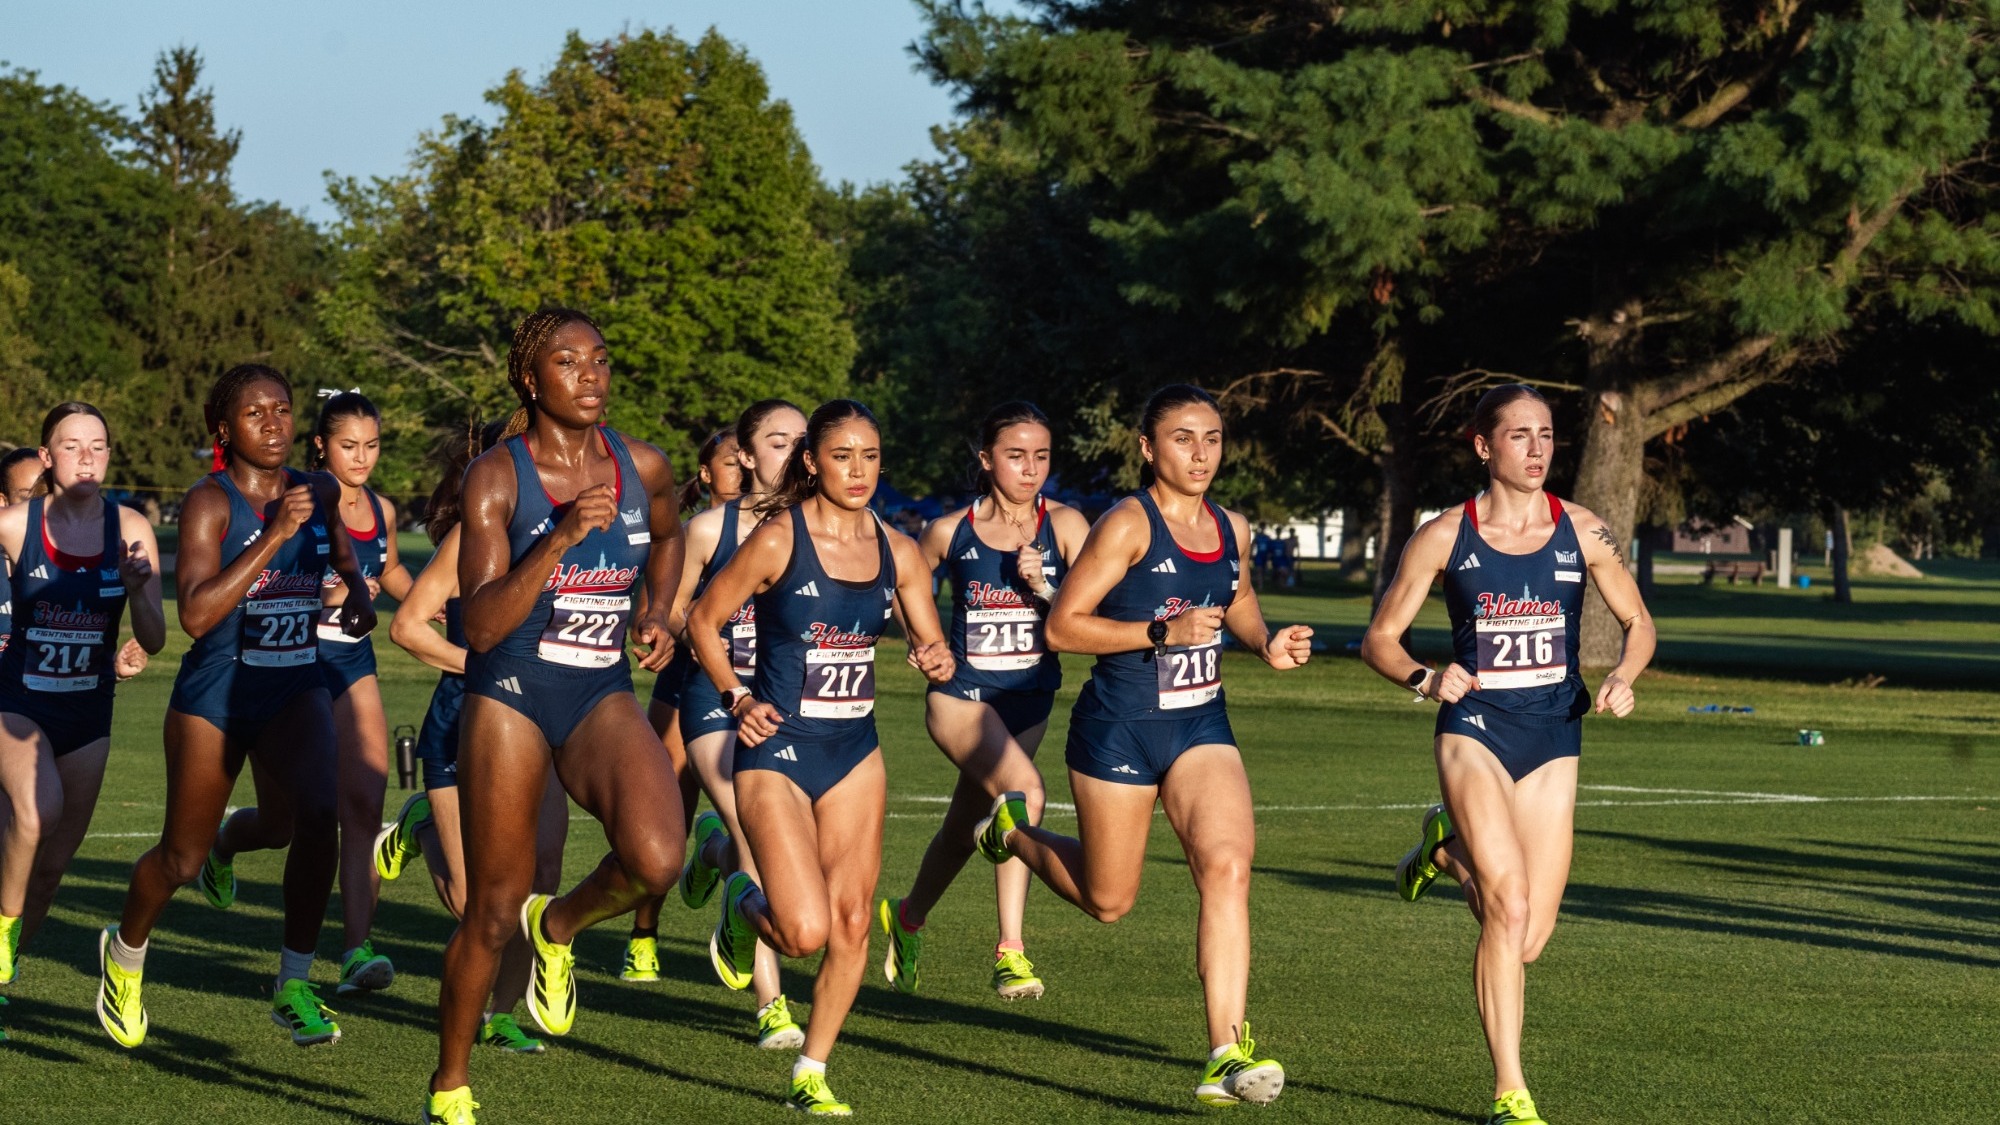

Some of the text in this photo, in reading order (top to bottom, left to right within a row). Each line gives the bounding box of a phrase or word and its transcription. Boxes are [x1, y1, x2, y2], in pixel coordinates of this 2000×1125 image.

[1555, 550, 1577, 564] VALLEY
[256, 601, 294, 610] FIGHTING
[295, 599, 319, 607] ILLINI
[564, 596, 606, 606] FIGHTING
[1478, 592, 1560, 619] Flames
[35, 630, 99, 640] FIGHTING ILLINI
[259, 613, 310, 647] 223
[558, 613, 620, 646] 222
[1486, 617, 1558, 627] FIGHTING ILLINI
[980, 623, 1034, 652] 215
[1493, 631, 1553, 667] 216
[38, 643, 91, 674] 214
[1171, 649, 1217, 687] 218
[818, 665, 868, 697] 217
